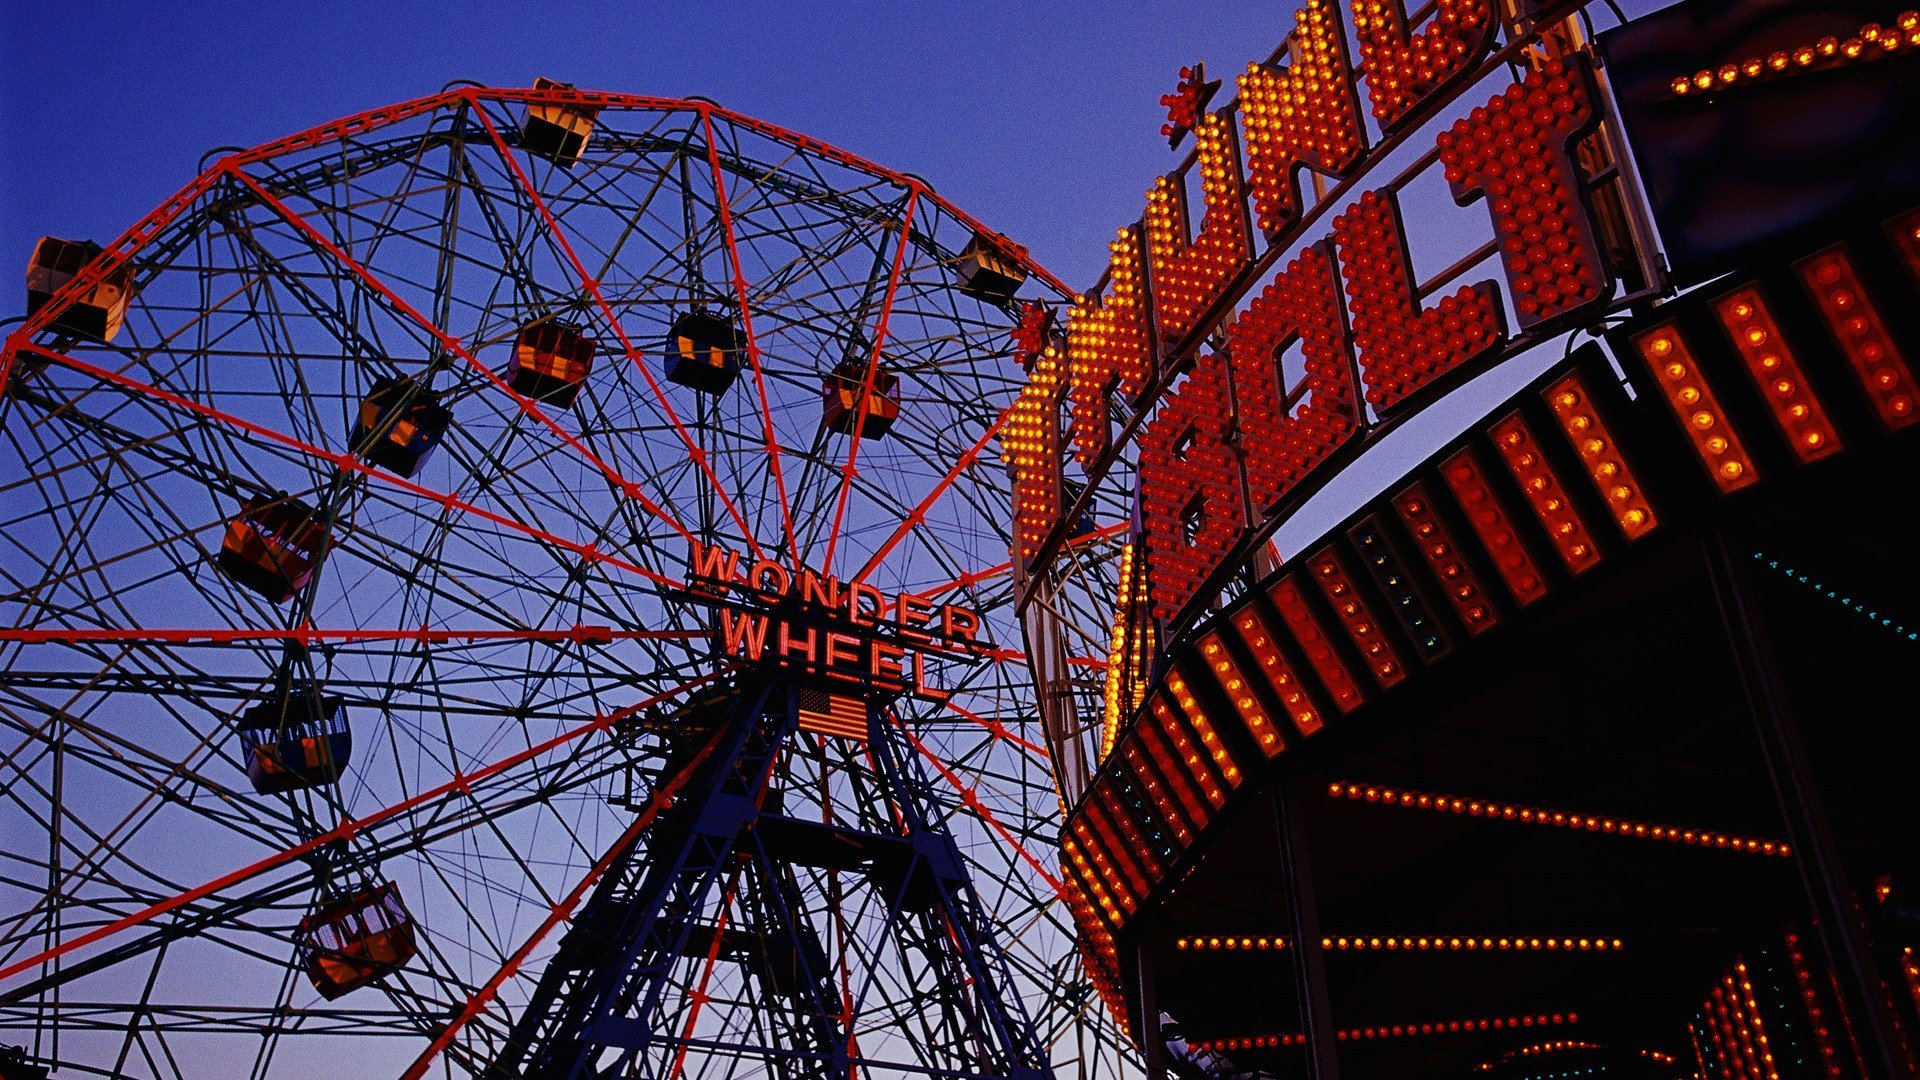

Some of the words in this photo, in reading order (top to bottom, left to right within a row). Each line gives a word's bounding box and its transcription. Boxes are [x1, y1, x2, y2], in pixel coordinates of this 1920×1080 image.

[1139, 52, 1616, 632] BOLT
[691, 540, 980, 651] WONDER
[720, 607, 949, 699] WHEEL
